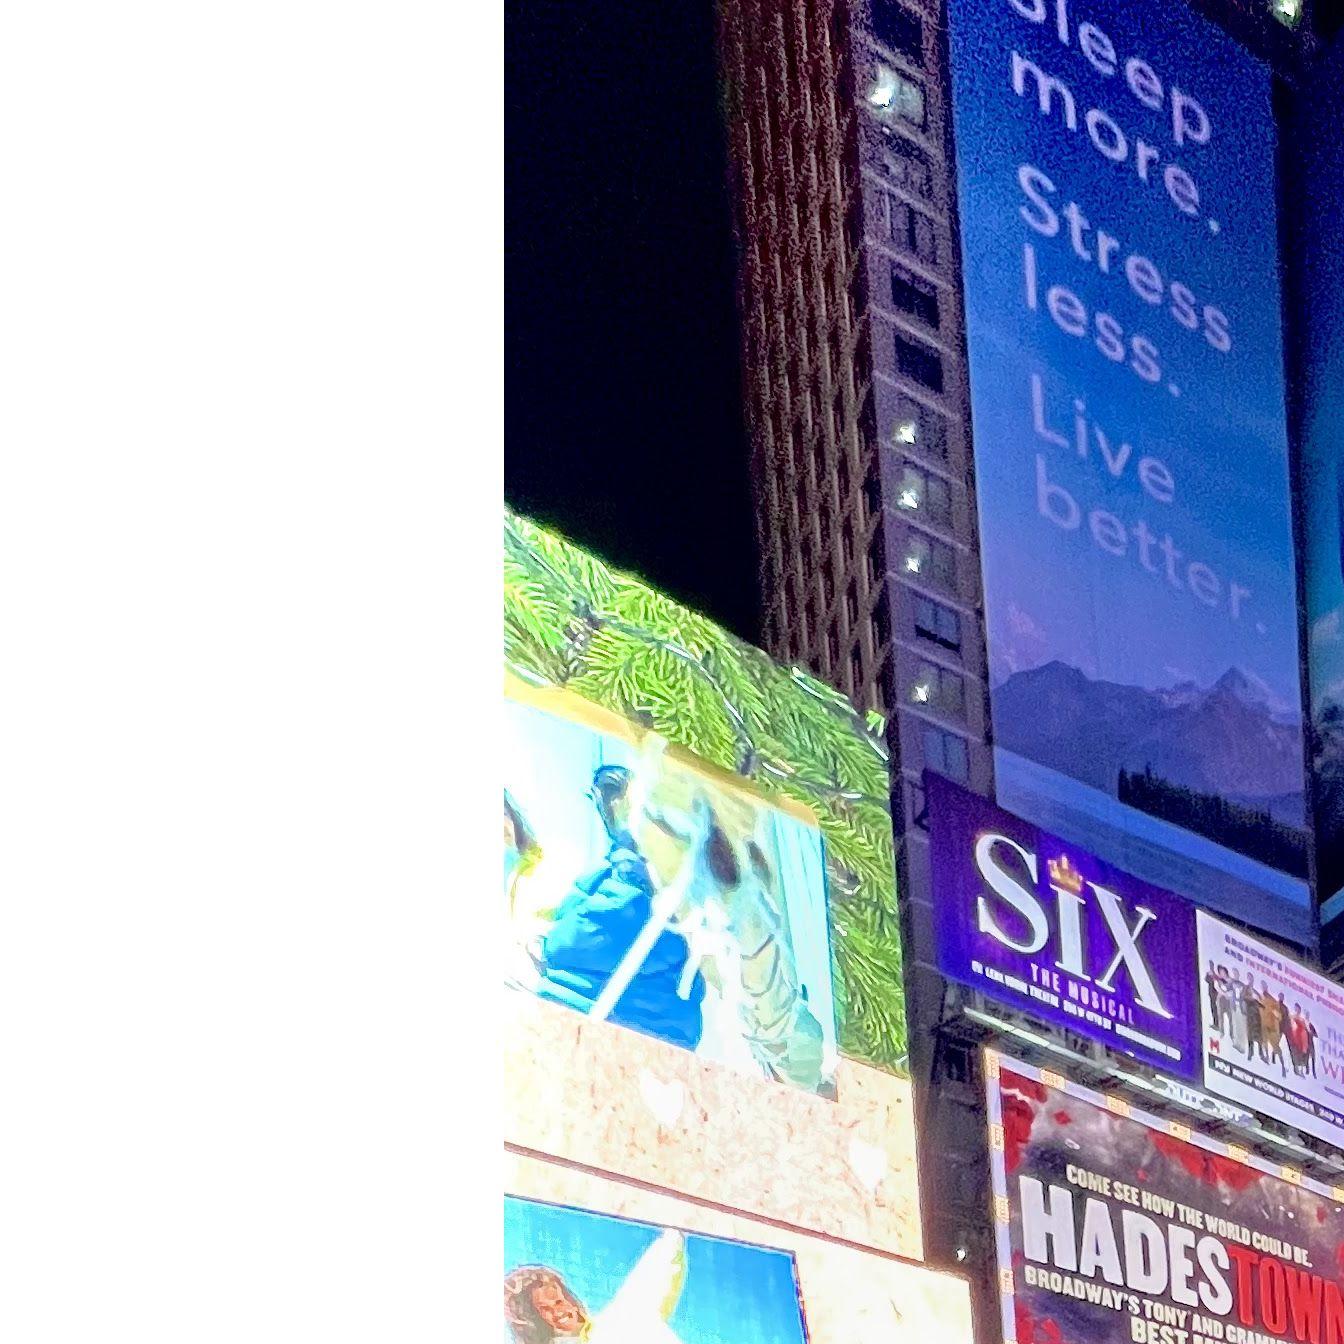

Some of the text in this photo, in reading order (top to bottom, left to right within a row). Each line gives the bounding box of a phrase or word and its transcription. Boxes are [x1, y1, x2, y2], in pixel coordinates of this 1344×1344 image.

[1011, 50, 1221, 234] more.
[1018, 162, 1231, 351] Stress
[1024, 242, 1181, 397] less.
[1031, 373, 1175, 502] Live
[1036, 453, 1267, 634] better.
[975, 834, 1174, 1019] SIX
[1030, 962, 1135, 1025] THE MUSICAL
[1066, 1163, 1112, 1197] COME
[1112, 1180, 1140, 1207] SEE
[1141, 1189, 1176, 1219] HOW
[1176, 1203, 1204, 1231] THE
[1204, 1213, 1251, 1246] WORLD
[1252, 1231, 1293, 1262] COULD
[1024, 1264, 1141, 1316] BROADWAY'S
[1191, 1313, 1225, 1340] AND
